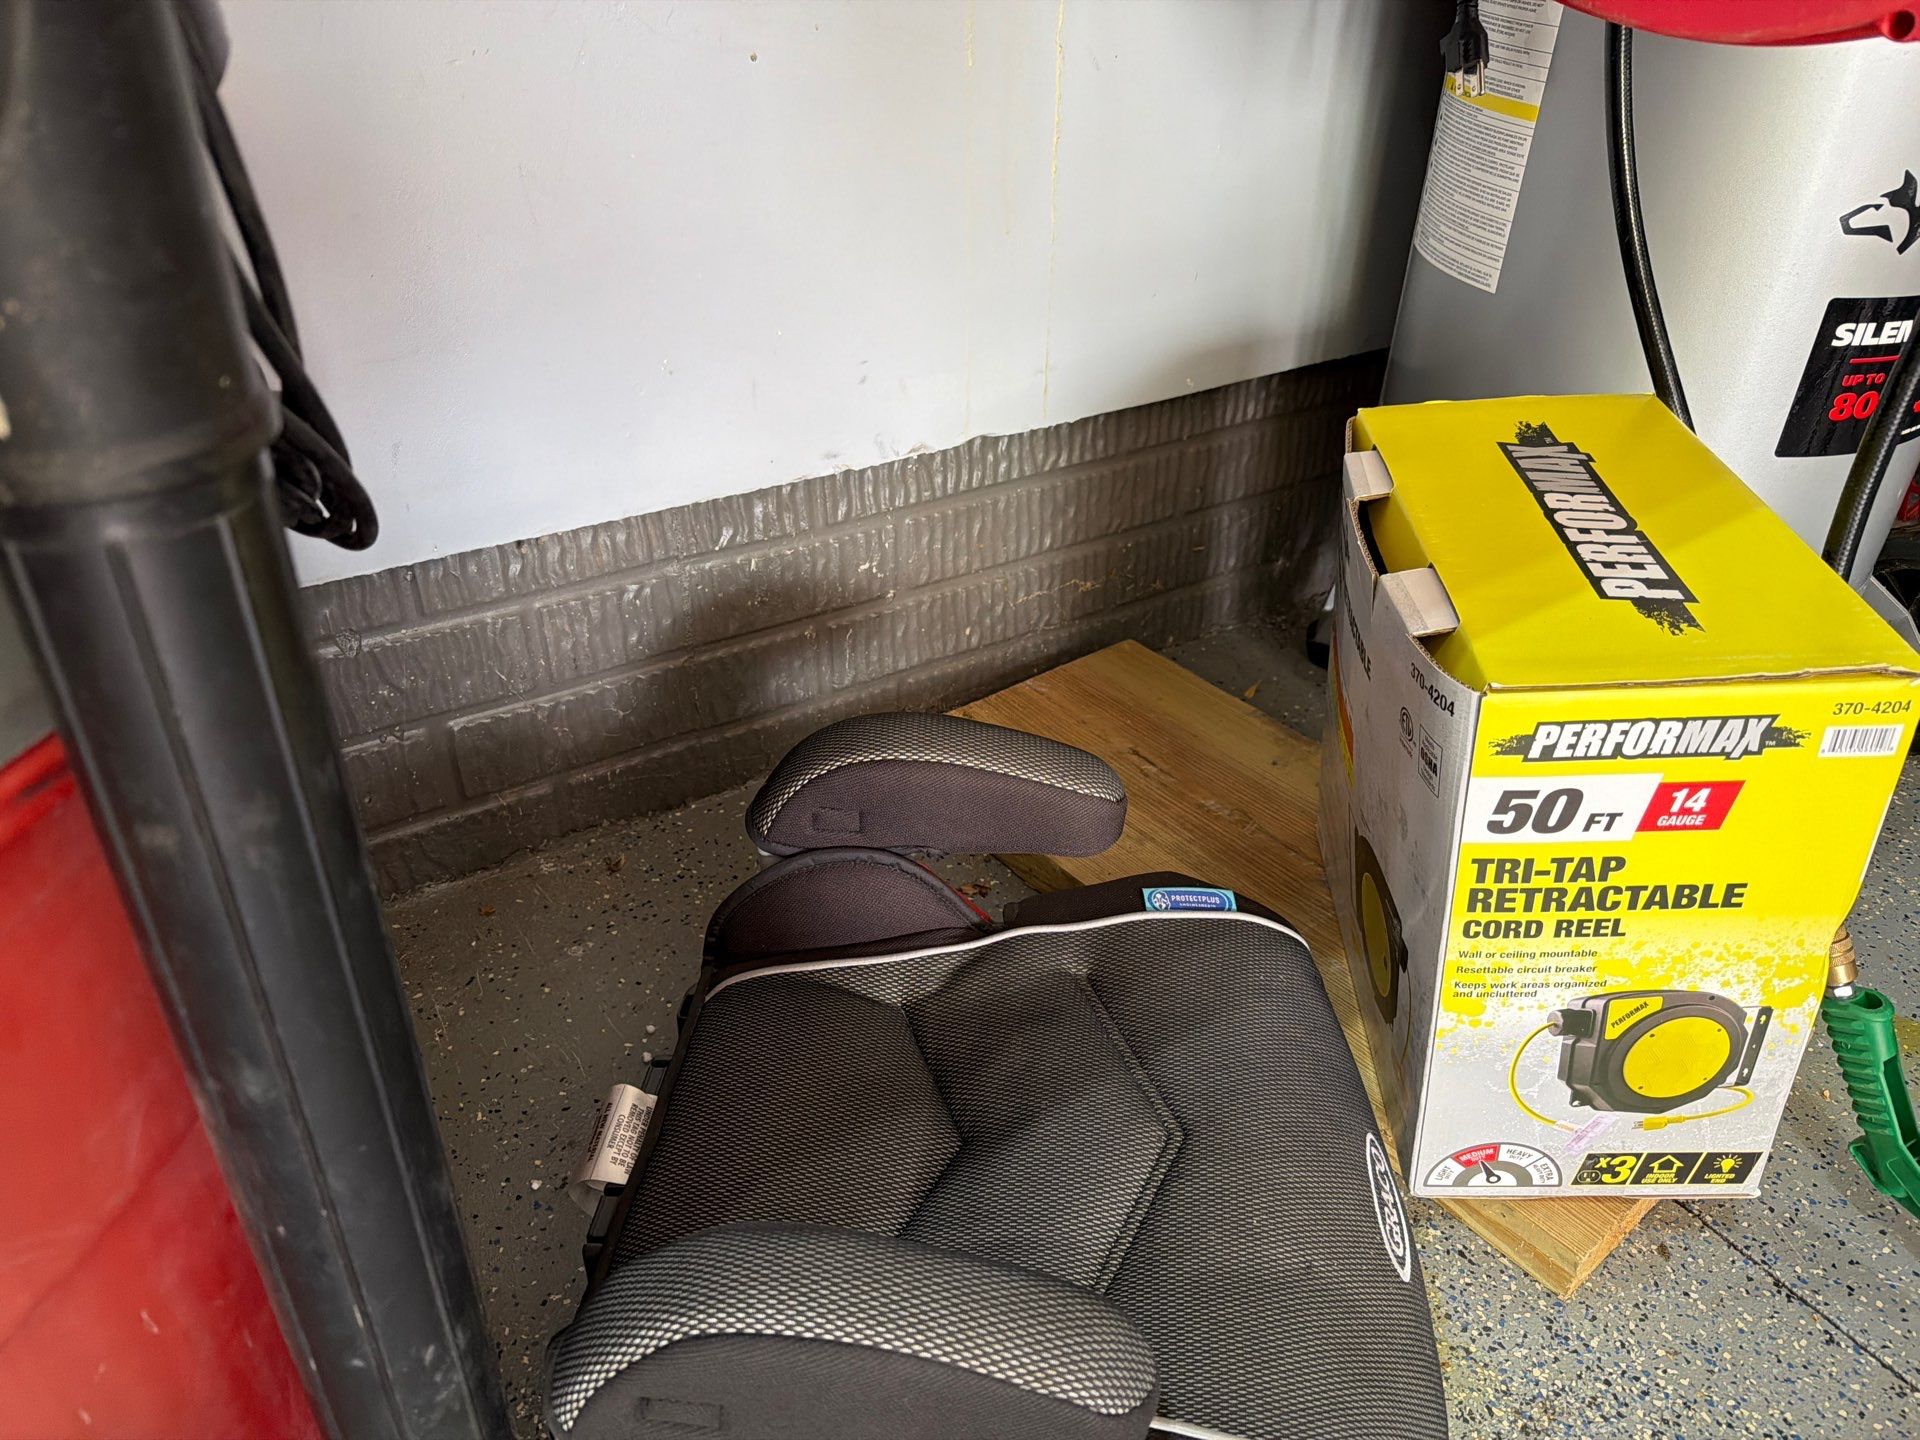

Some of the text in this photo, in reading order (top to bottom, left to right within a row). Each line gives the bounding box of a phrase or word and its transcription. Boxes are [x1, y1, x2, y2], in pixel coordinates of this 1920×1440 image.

[1842, 373, 1886, 387] UP TO
[1828, 391, 1880, 421] 80
[1506, 444, 1685, 600] PERFORMAX
[1410, 662, 1455, 717] 370-4204
[1833, 700, 1911, 715] 370-4204
[1527, 717, 1772, 758] PERFORMAX
[1669, 787, 1712, 812] 14
[1486, 788, 1624, 834] 50 FT
[1656, 814, 1707, 827] GAUGE
[1470, 856, 1627, 884] TRI-TAP
[1170, 894, 1221, 904] PROTECTPLUS
[1466, 882, 1749, 913] RETRACTABLE
[1462, 918, 1627, 939] CORD REEL
[1458, 950, 1482, 958] Wall
[1500, 950, 1536, 960] ceiling
[1539, 949, 1598, 958] mountable
[1456, 965, 1598, 974] Resettable circuit breaker
[1453, 989, 1538, 998] and uncluttered
[1454, 979, 1607, 990] Keeps work areas organized
[1611, 1001, 1650, 1029] PERFORMAX
[640, 1106, 653, 1127] UNDER
[607, 1114, 626, 1149] CONSUMER
[609, 1103, 639, 1166] REMOVED EXCEPT BY
[617, 1107, 645, 1168] THIS TAG NOT TO BE
[633, 1126, 647, 1151] PENALTY
[629, 1151, 638, 1161] OF
[1459, 1148, 1494, 1162] MEDIUM
[1506, 1148, 1533, 1159] HEAVY
[1435, 1165, 1451, 1180] LIGHT
[1540, 1162, 1554, 1181] EXTRA
[1370, 1146, 1404, 1257] GRACO
